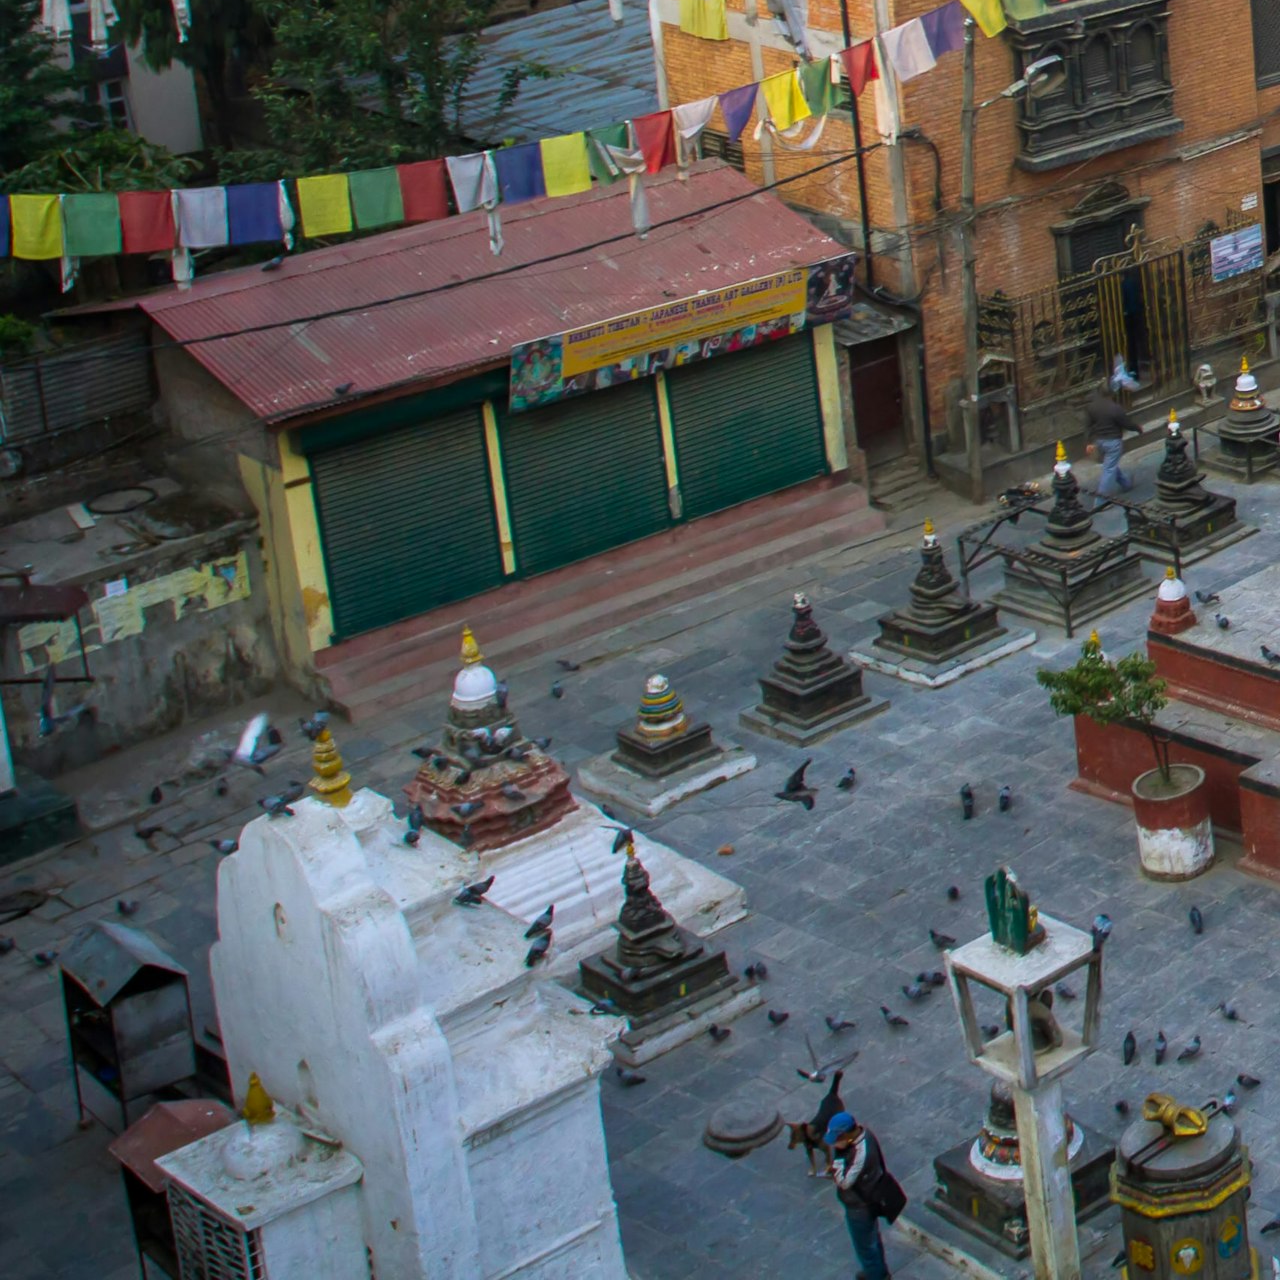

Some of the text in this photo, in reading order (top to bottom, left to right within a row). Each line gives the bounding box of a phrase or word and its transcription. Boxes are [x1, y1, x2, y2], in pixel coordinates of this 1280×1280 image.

[651, 302, 689, 321] JAPANESE
[724, 289, 739, 301] ART
[741, 279, 774, 296] GALLERY
